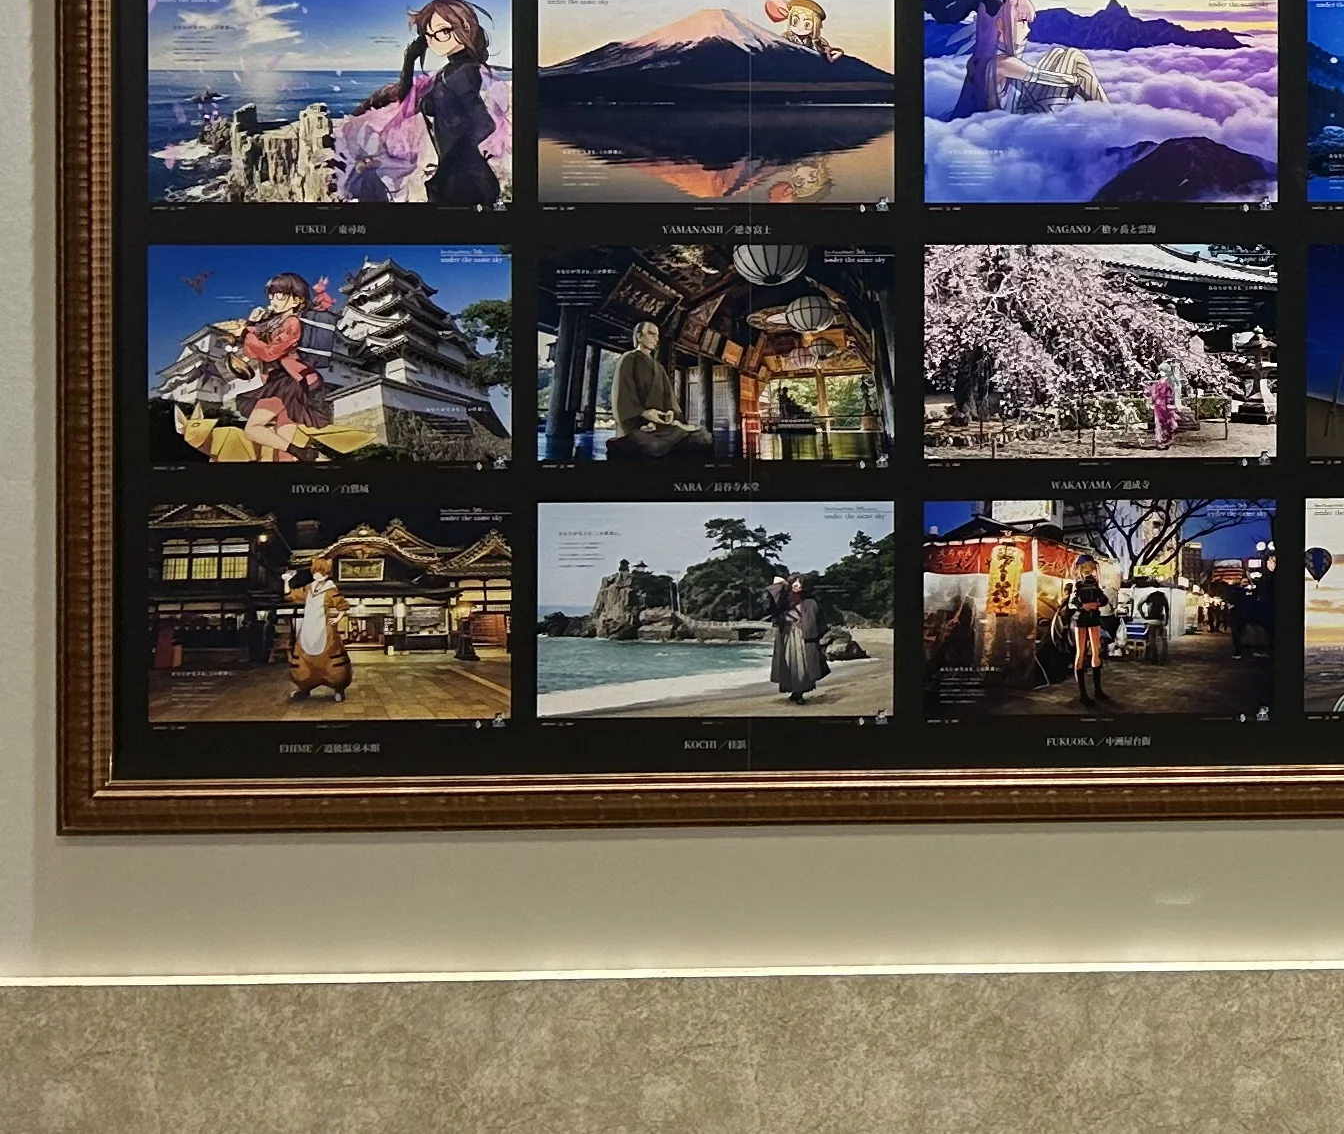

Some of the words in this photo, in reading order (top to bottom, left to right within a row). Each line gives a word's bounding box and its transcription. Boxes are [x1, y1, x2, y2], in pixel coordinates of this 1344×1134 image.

[294, 224, 327, 234] FUKUI
[661, 225, 724, 234] YAMANASHI
[1046, 224, 1092, 234] NAGANO
[291, 484, 330, 494] HYOGO
[673, 482, 703, 492] NARA
[1050, 480, 1112, 490] WAKAYAMA
[683, 740, 717, 750] KOCHI
[1046, 737, 1096, 747] FUKUOKA
